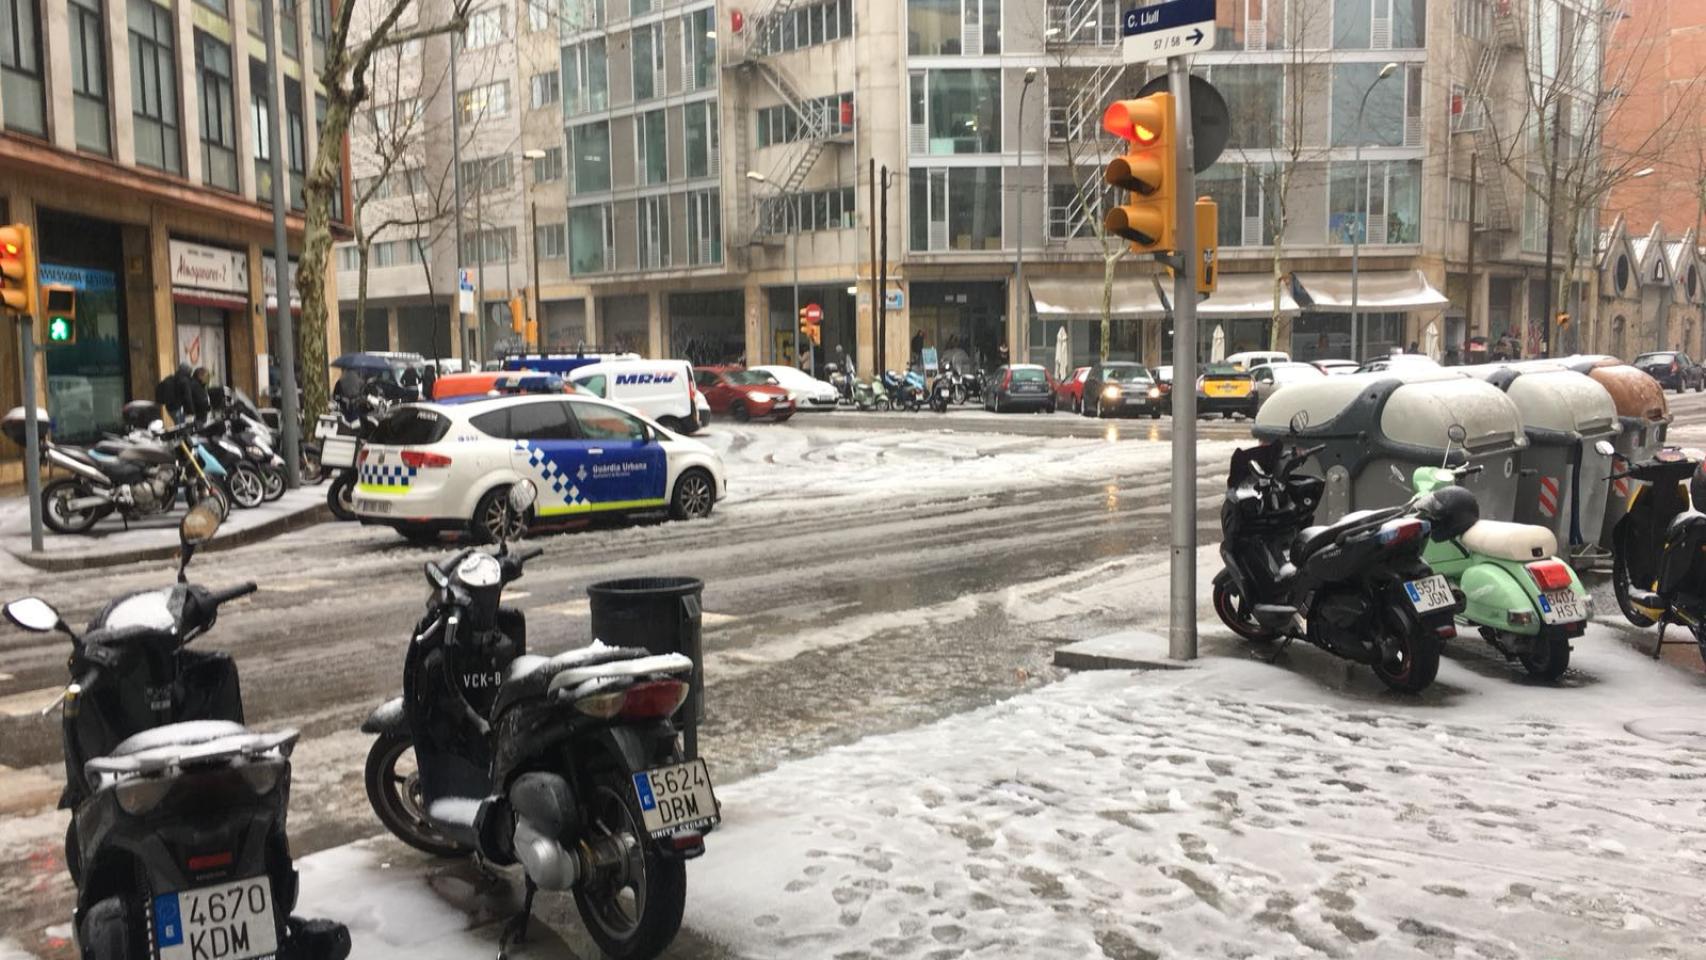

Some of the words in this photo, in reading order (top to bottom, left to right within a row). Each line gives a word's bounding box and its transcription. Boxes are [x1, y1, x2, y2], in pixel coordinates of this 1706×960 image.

[1127, 14, 1138, 28] C.
[1141, 9, 1160, 26] Llull
[1153, 39, 1162, 50] 57
[1171, 35, 1181, 47] 58
[615, 371, 678, 385] MRW
[622, 461, 648, 472] Urbana
[1415, 577, 1446, 595] 5574
[1427, 590, 1449, 607] JGN
[1555, 603, 1579, 619] HST
[650, 765, 705, 797] 5624
[658, 792, 699, 825] DBM
[651, 827, 676, 840] UNITY
[190, 884, 266, 926] 4670
[190, 920, 250, 960] KDM
